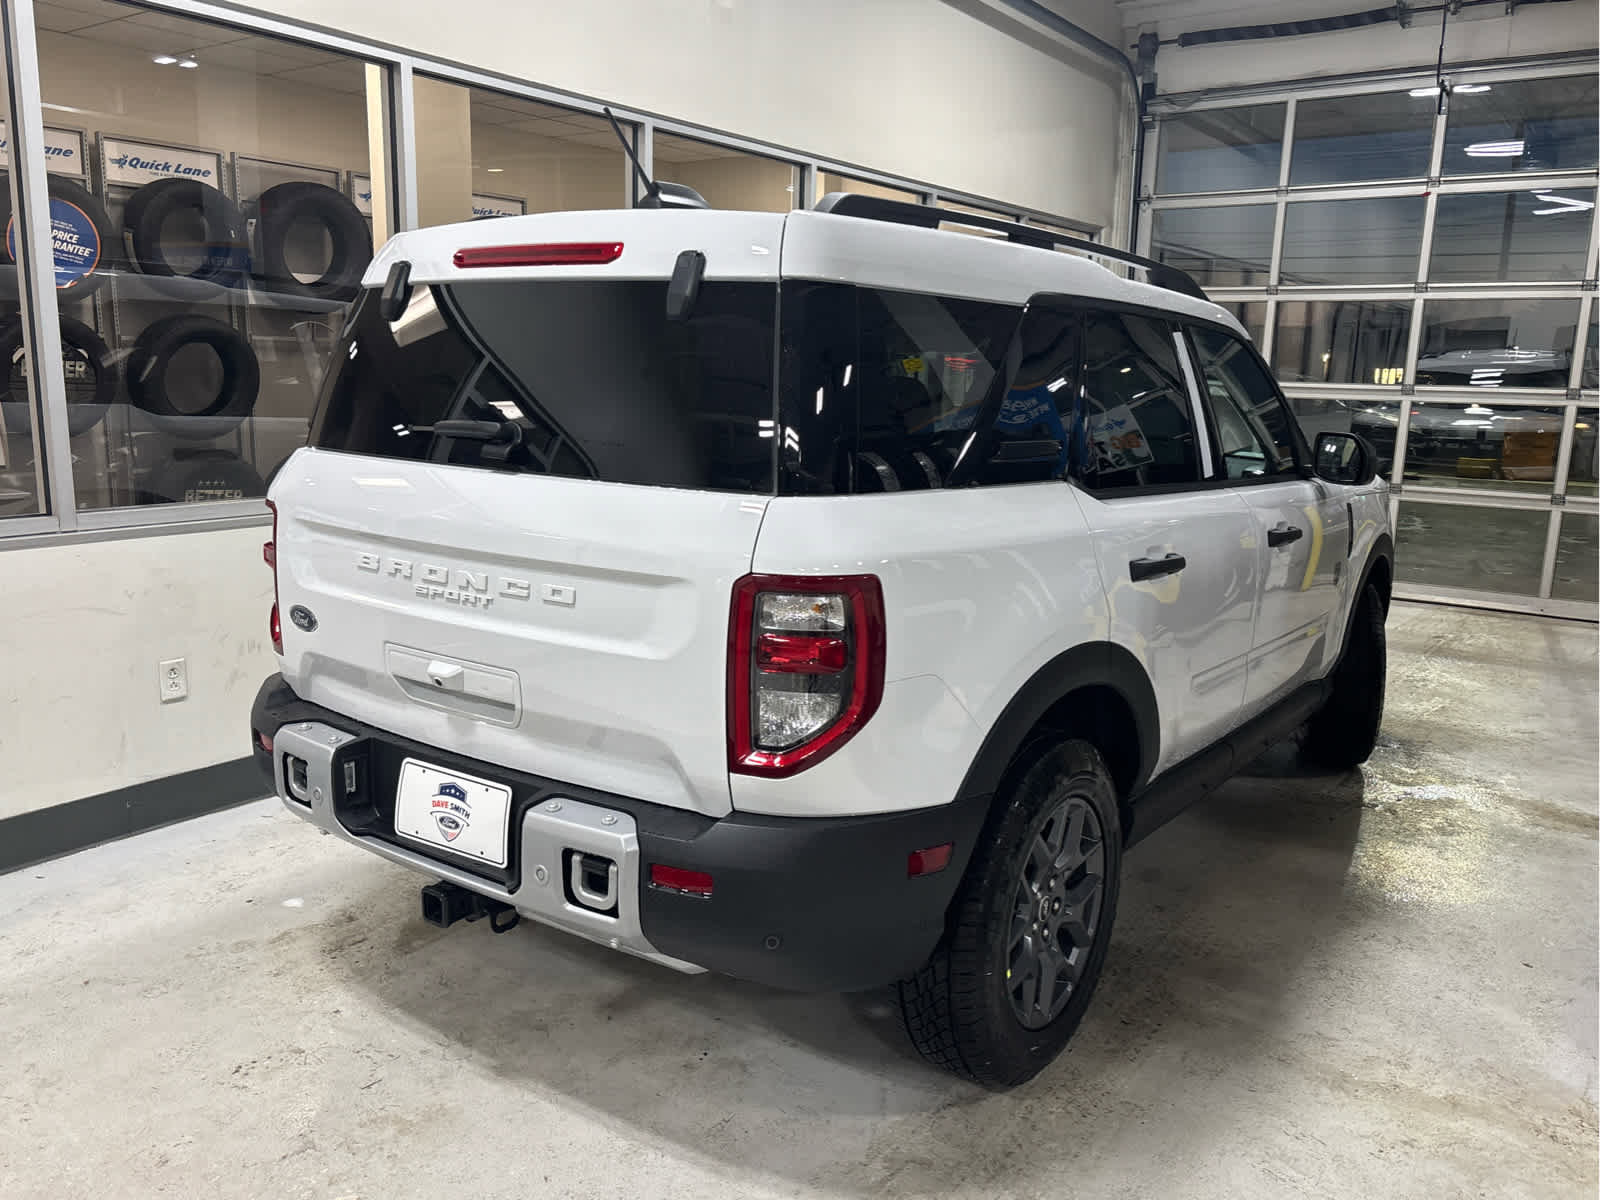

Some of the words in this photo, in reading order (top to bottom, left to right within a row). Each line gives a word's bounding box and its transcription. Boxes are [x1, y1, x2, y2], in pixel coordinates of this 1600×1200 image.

[128, 156, 172, 173] Quick
[173, 163, 211, 178] Lane
[52, 229, 80, 244] PRICE
[51, 240, 92, 257] RANTEE
[356, 552, 576, 608] BRONCO
[415, 584, 494, 609] SPORT
[432, 800, 448, 808] DAVE
[450, 803, 470, 818] SMITH
